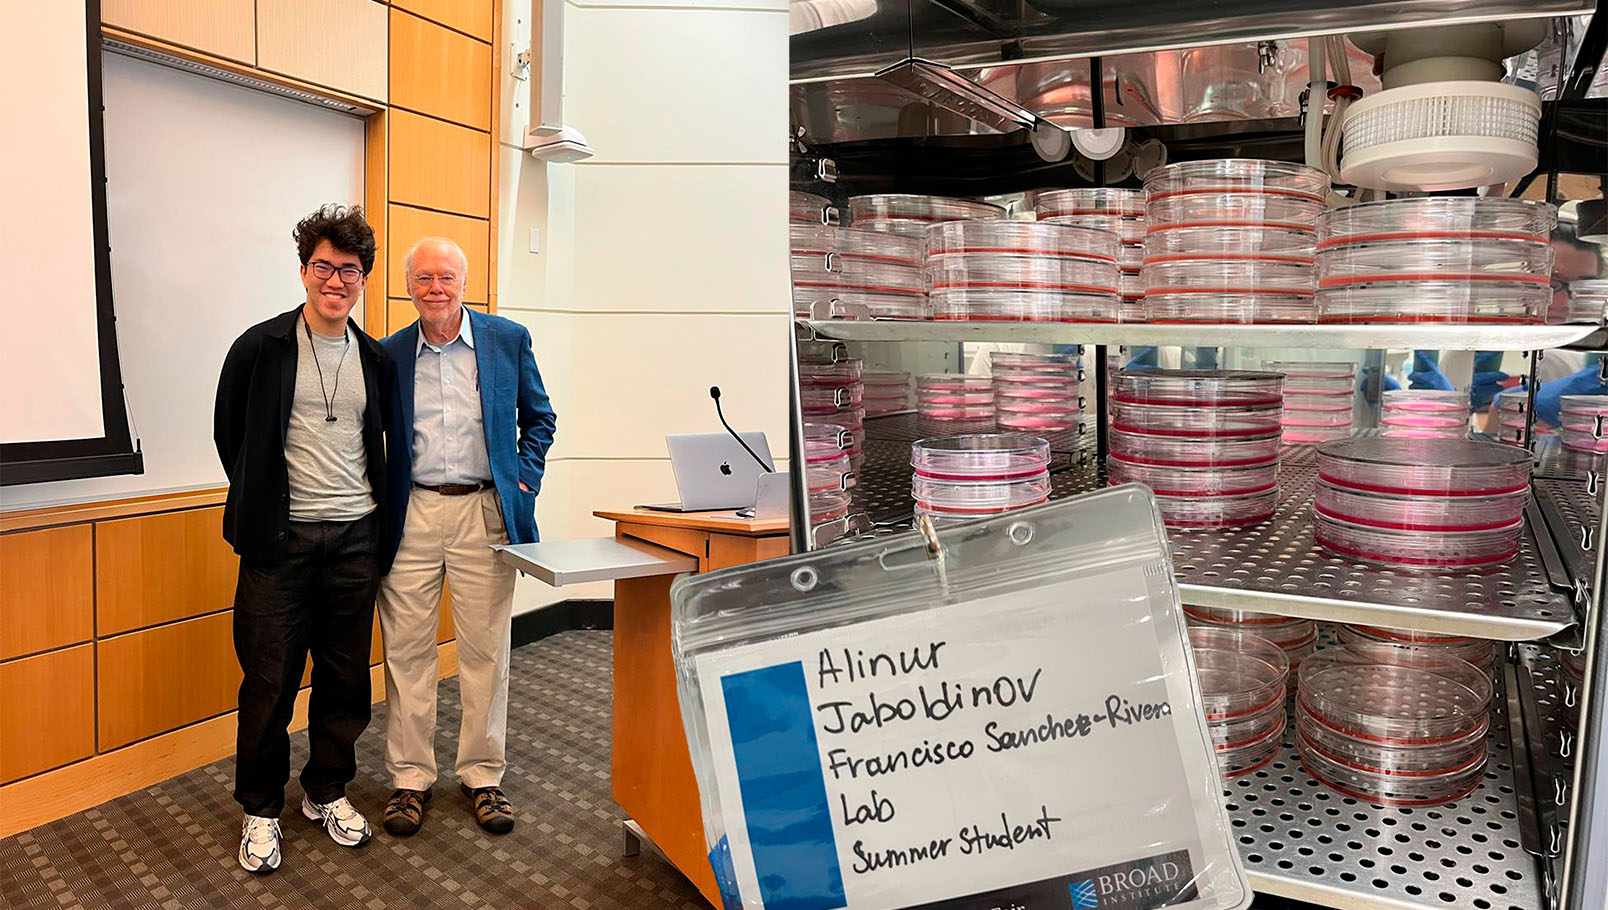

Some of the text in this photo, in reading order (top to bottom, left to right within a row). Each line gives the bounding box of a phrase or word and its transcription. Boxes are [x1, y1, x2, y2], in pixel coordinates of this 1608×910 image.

[818, 641, 946, 689] Alinur
[827, 740, 974, 779] Francisco
[840, 789, 895, 826] Lab
[852, 840, 952, 874] Summer
[1098, 861, 1180, 896] BROAD
[1103, 881, 1180, 906] INSTITUTE
